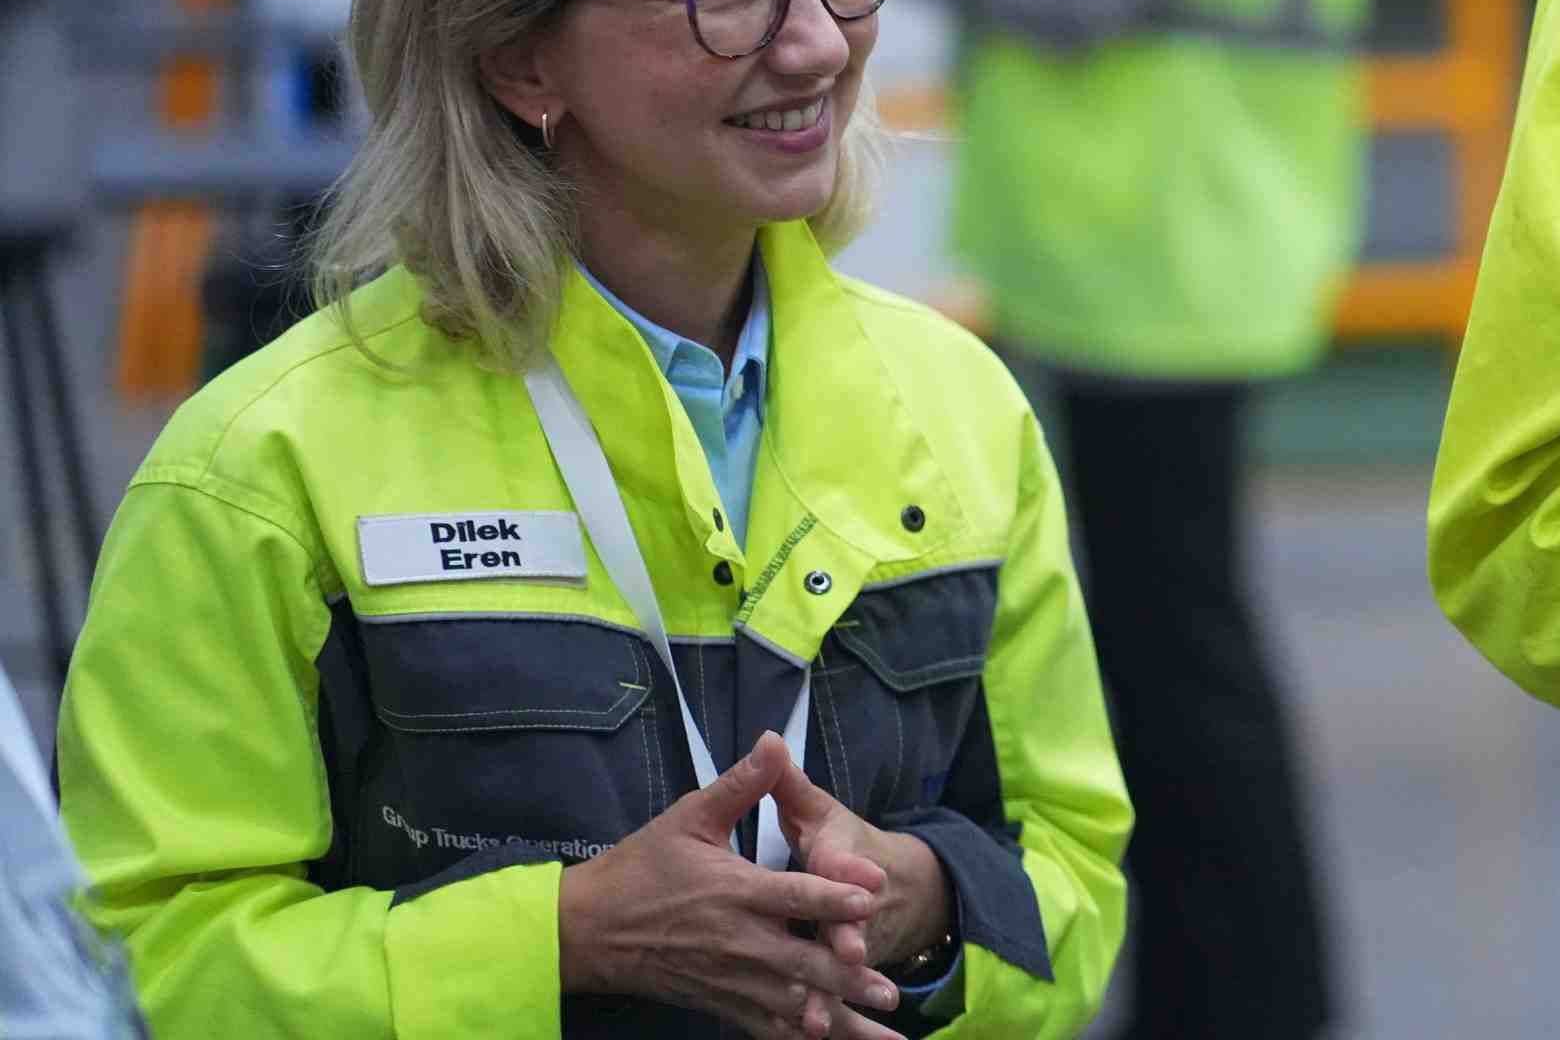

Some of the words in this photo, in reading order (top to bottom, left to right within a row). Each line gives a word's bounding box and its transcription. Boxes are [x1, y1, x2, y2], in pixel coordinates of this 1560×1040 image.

[429, 518, 522, 544] Dilek
[439, 548, 522, 570] Eren
[431, 827, 499, 851] Trucks
